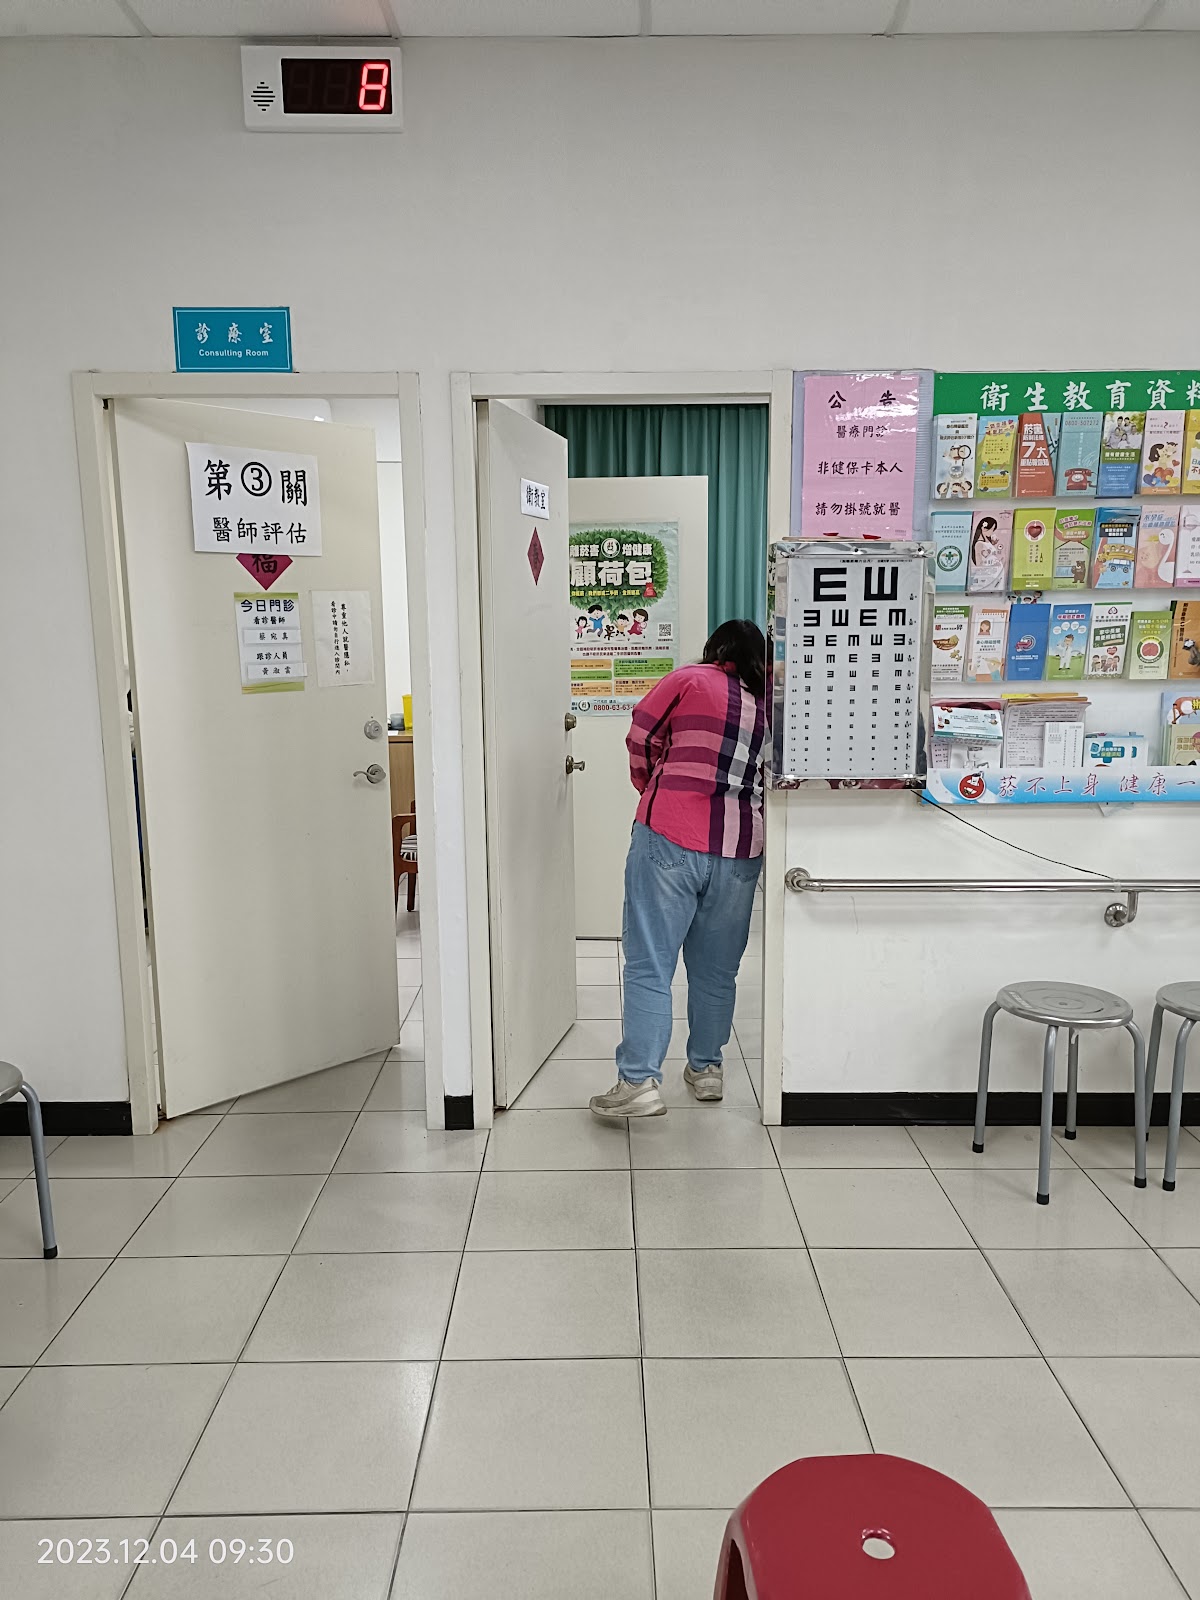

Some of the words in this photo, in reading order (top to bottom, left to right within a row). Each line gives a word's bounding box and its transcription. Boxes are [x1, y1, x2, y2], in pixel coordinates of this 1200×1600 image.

[358, 63, 389, 110] 8
[195, 322, 274, 343] 診療室
[198, 348, 242, 359] Consulting
[245, 348, 269, 357] Room
[828, 390, 897, 409] 公告
[836, 425, 888, 438] 醫療門診
[817, 461, 903, 475] 非健保卡本人
[815, 502, 900, 516] 請勿掛號就醫
[212, 516, 307, 544] 醫師評估
[622, 543, 653, 557] 增健康
[570, 560, 653, 587] 顧荷包
[240, 599, 295, 613] 今日門診
[253, 616, 286, 625] 看診醫師
[256, 651, 289, 660] 跟診人員
[998, 773, 1100, 797] 菸不上身
